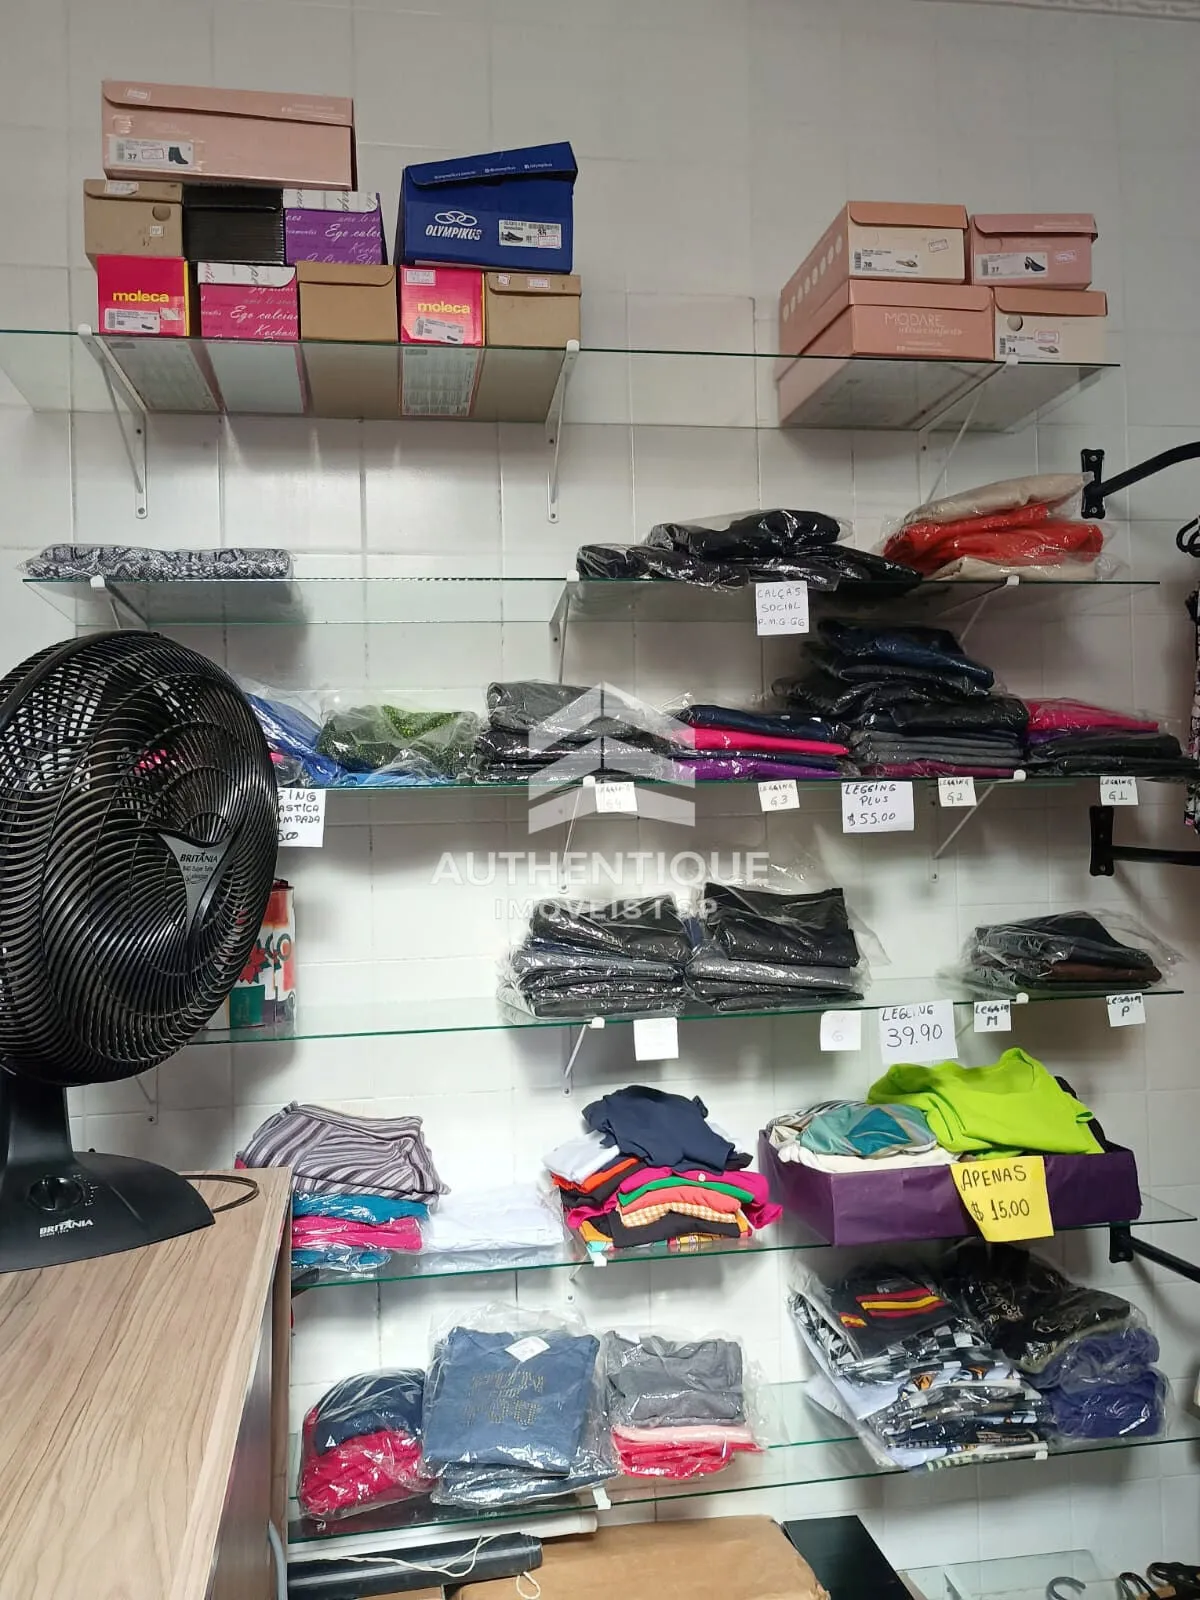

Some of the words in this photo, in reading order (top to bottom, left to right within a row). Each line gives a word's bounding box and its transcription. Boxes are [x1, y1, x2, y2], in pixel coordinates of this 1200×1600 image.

[425, 225, 482, 241] OLYMPIKUS
[112, 289, 170, 303] moleca
[230, 305, 254, 323] Ego
[417, 301, 471, 315] moleca
[884, 312, 945, 328] MODARE
[757, 587, 801, 600] CALÇAS
[761, 602, 801, 613] SOCIAL
[845, 784, 897, 795] LEGGING
[770, 795, 789, 807] G3
[859, 795, 889, 807] PLUS
[946, 791, 964, 805] G2
[1121, 1005, 1130, 1017] P
[986, 1015, 998, 1026] M
[886, 1023, 943, 1048] 39.90
[961, 1164, 1027, 1191] APENAS
